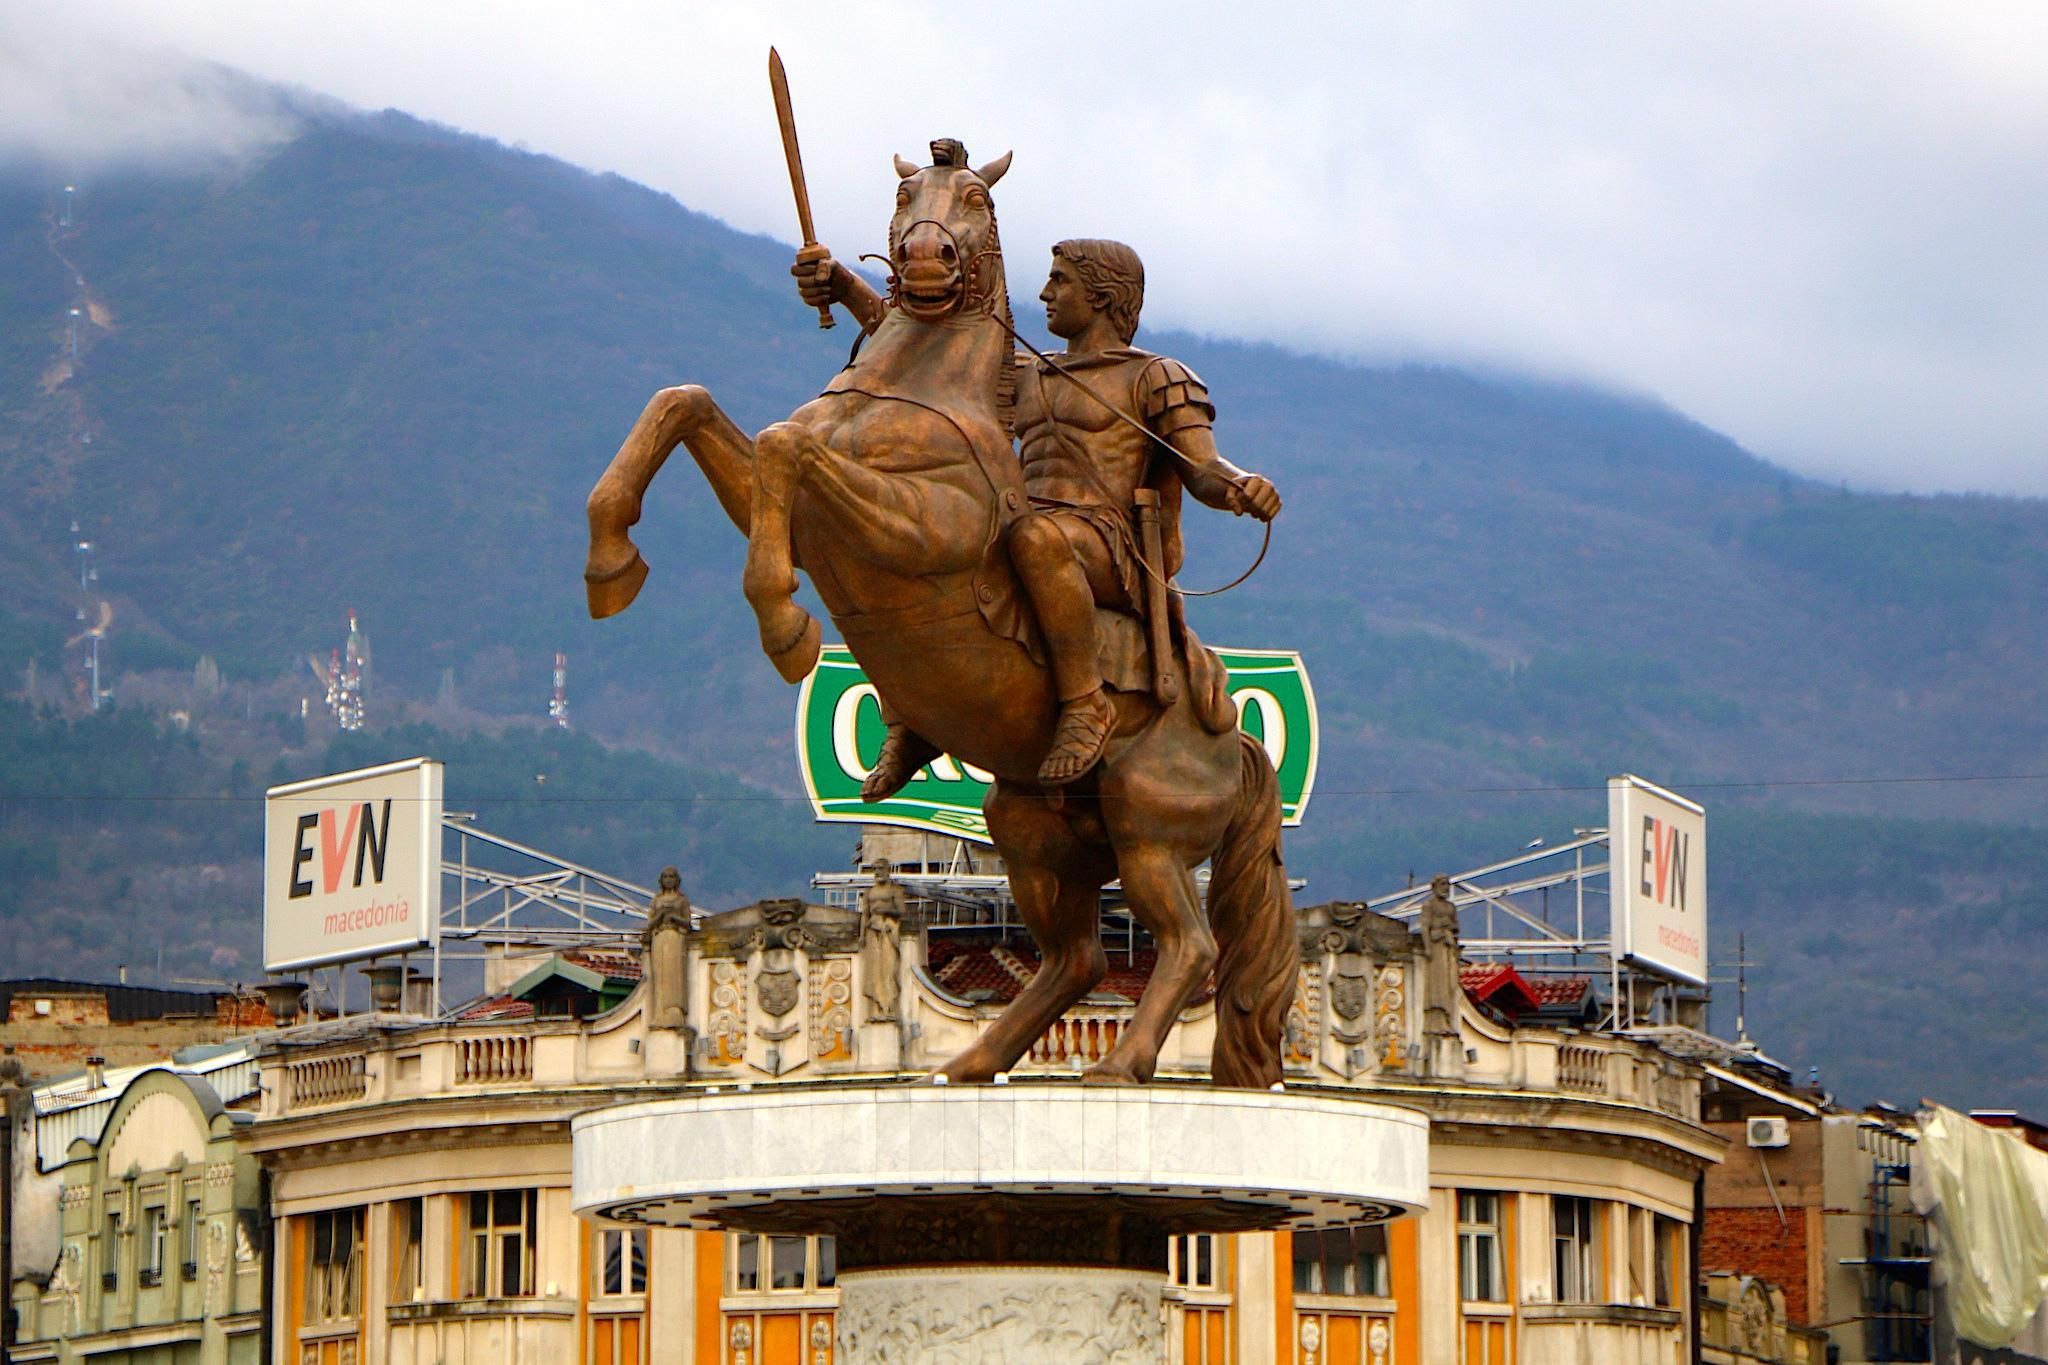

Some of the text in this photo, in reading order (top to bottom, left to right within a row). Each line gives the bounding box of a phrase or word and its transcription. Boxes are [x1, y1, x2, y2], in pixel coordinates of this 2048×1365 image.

[288, 799, 391, 900] EVN
[1640, 815, 1689, 912] EVN
[324, 897, 409, 935] macedonia
